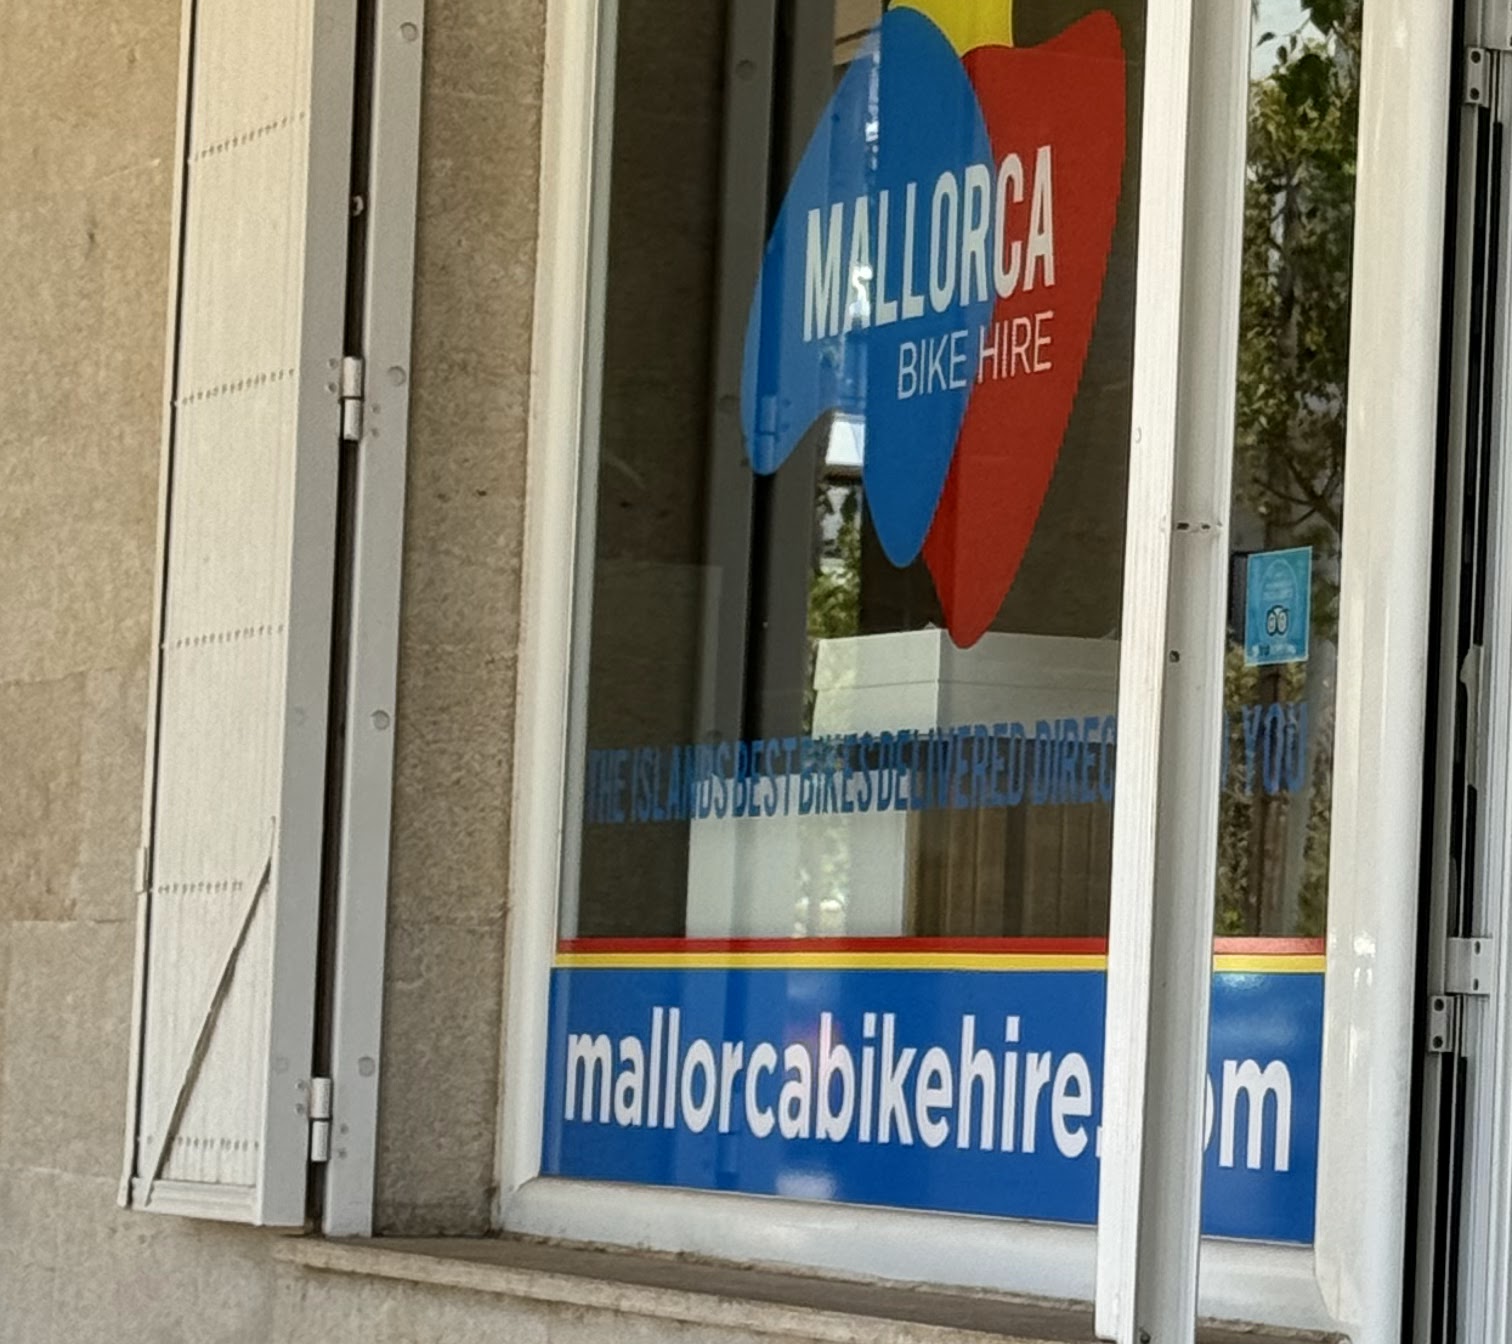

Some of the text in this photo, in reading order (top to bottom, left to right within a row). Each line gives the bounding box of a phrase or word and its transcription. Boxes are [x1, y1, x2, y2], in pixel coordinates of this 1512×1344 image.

[803, 144, 1056, 343] MALLORCA
[896, 311, 1055, 401] BIKE HIRE
[587, 747, 629, 825] THE
[631, 738, 732, 823] ISLANDS
[732, 733, 798, 818] BEST
[799, 729, 874, 816] BIKES
[876, 721, 1027, 812] DELIVERED
[1033, 713, 1118, 806] DIREC
[1243, 702, 1308, 797] YOU
[563, 1006, 1293, 1173] mallorcabikehirem
